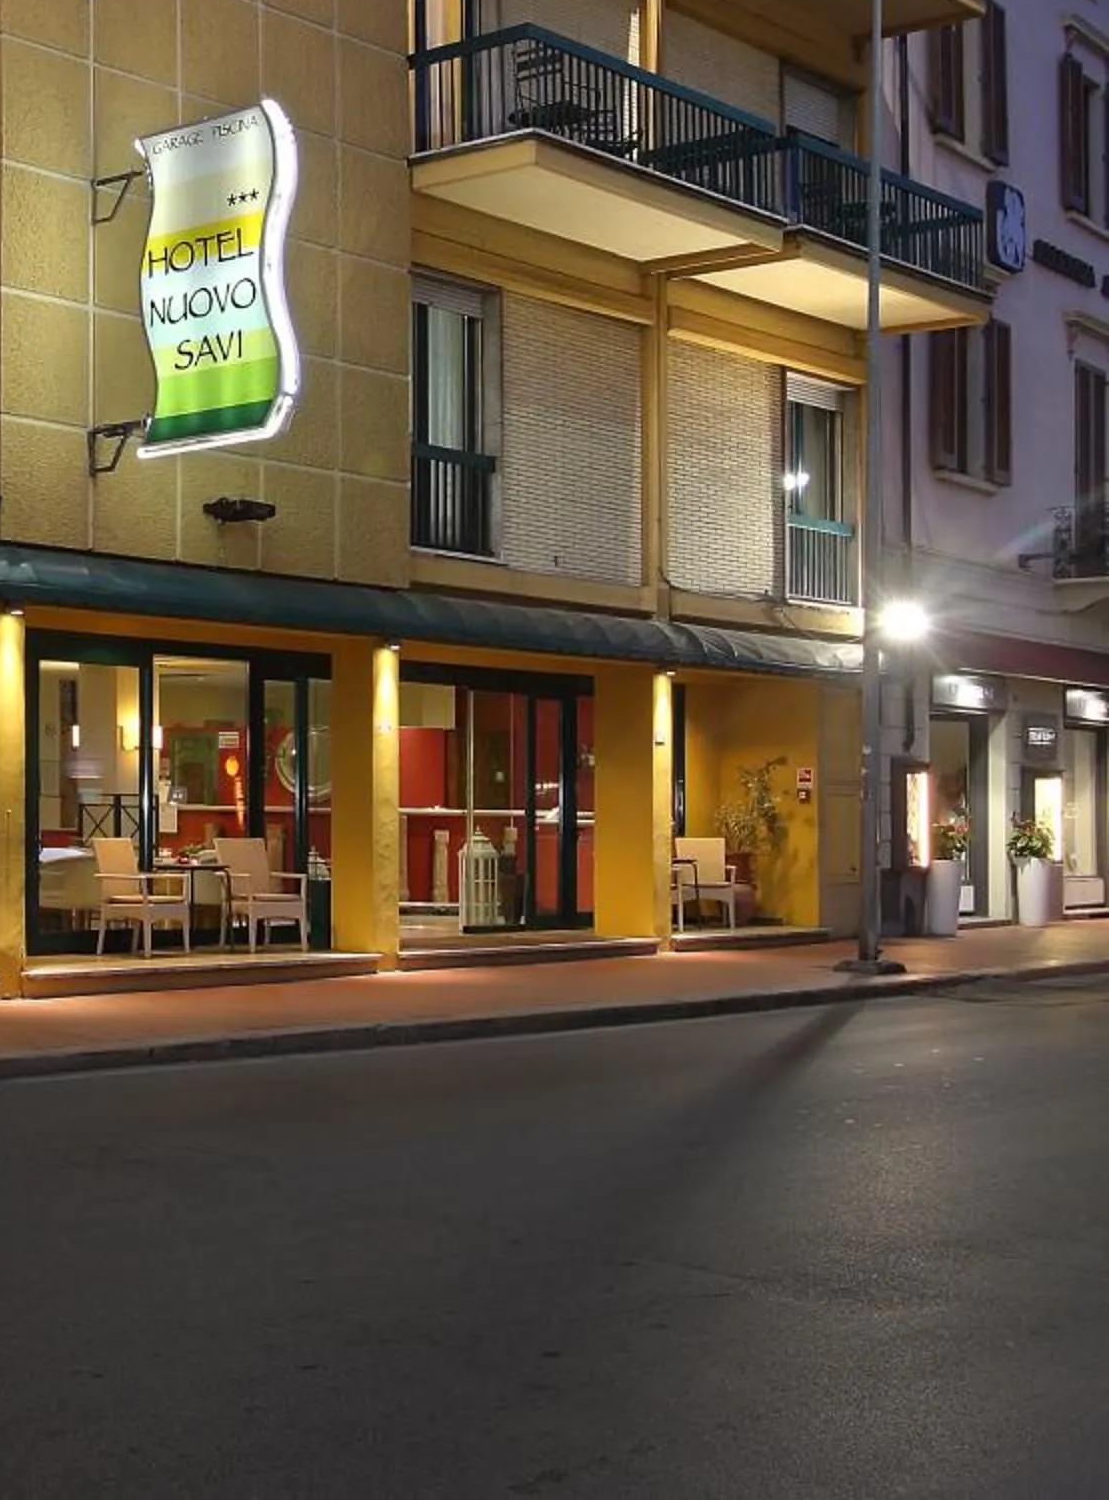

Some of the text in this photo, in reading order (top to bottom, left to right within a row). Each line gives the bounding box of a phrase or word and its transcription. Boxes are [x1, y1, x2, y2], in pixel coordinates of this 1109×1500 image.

[152, 130, 203, 154] GARAGE
[148, 227, 254, 279] HOTEL
[149, 277, 257, 328] NUOVO
[174, 330, 243, 370] SAVI
